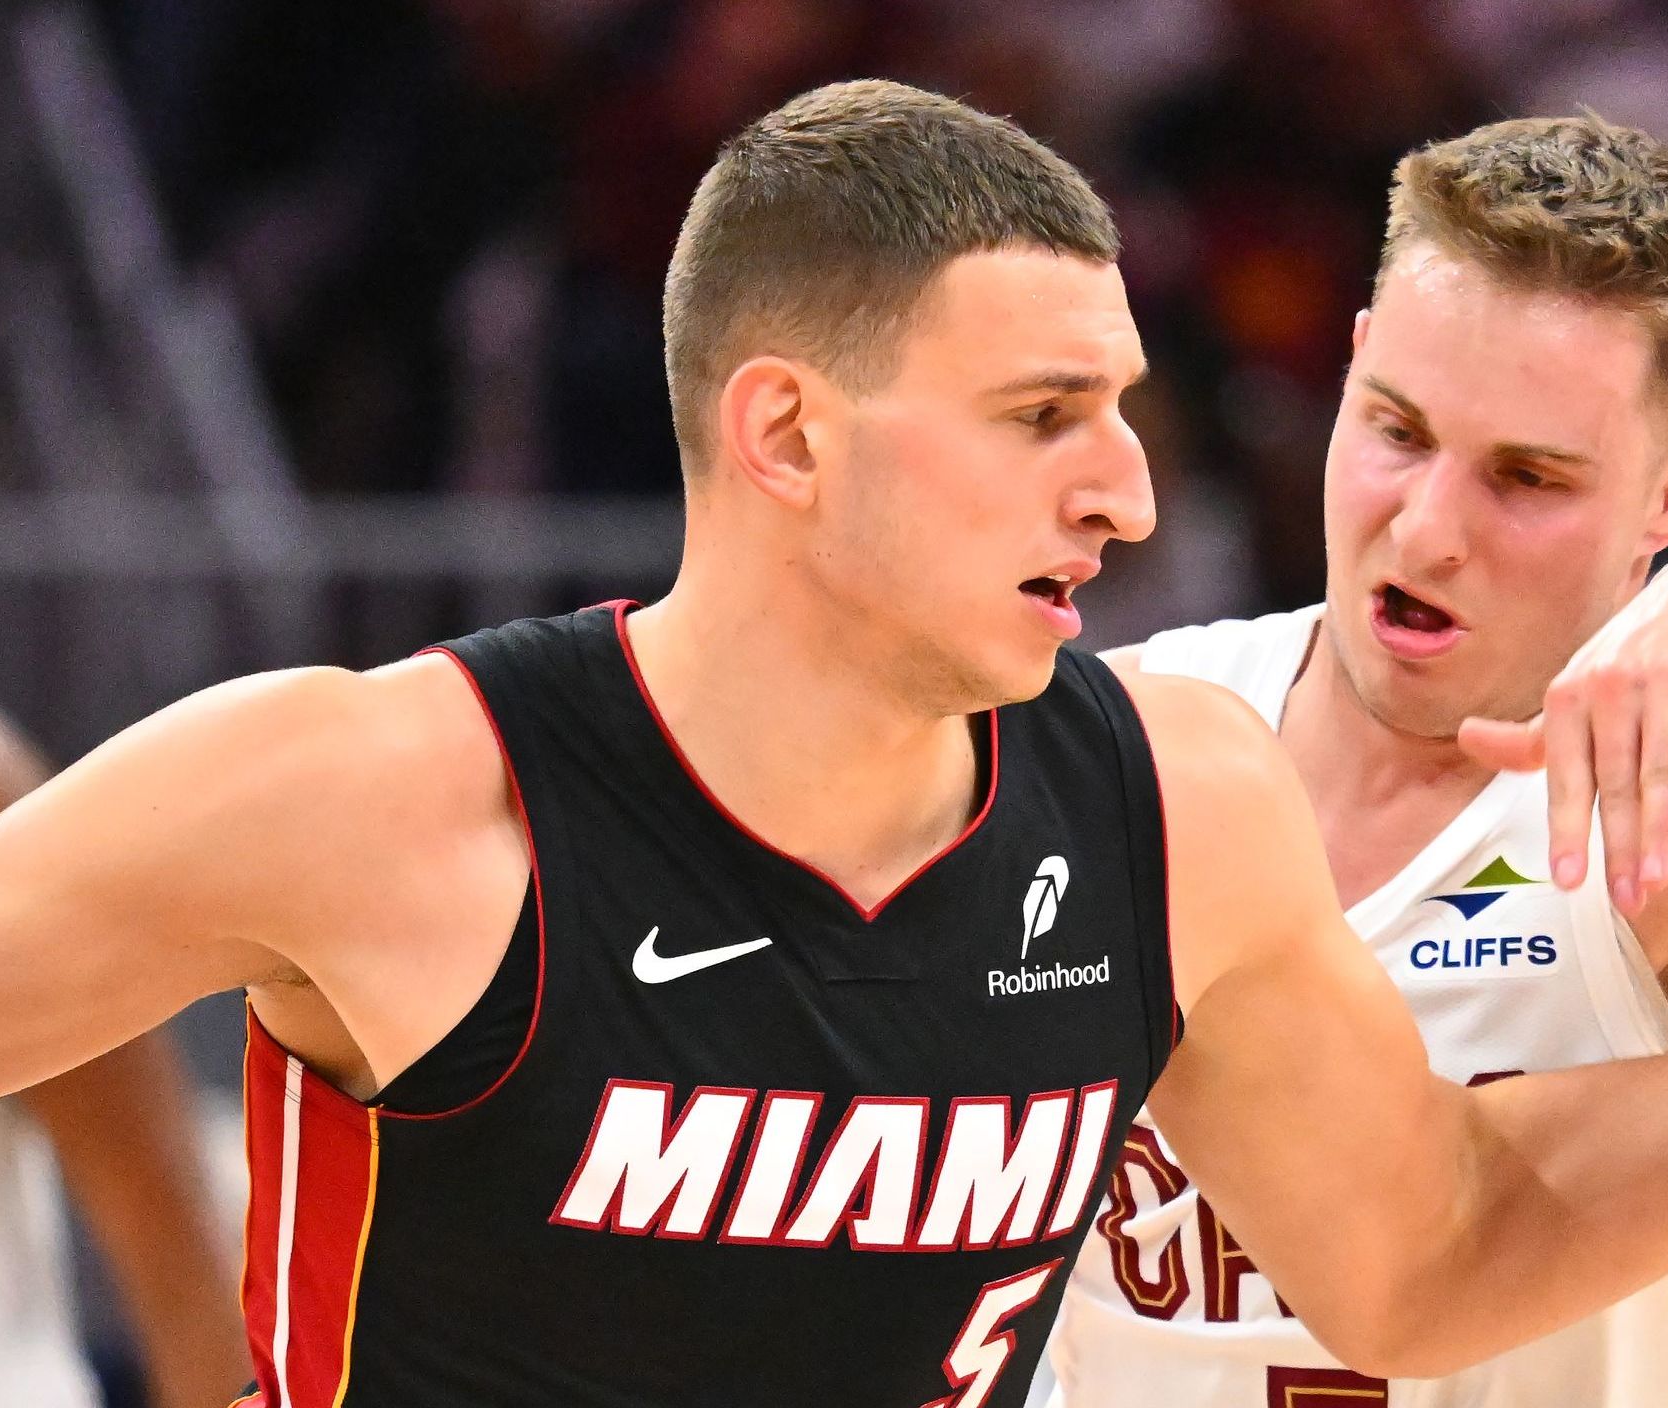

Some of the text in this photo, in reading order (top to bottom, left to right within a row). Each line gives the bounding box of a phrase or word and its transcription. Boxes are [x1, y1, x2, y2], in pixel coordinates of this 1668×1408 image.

[1409, 935, 1558, 970] CLIFFS
[987, 955, 1110, 997] Robinhood
[549, 1078, 1119, 1252] MIAMI
